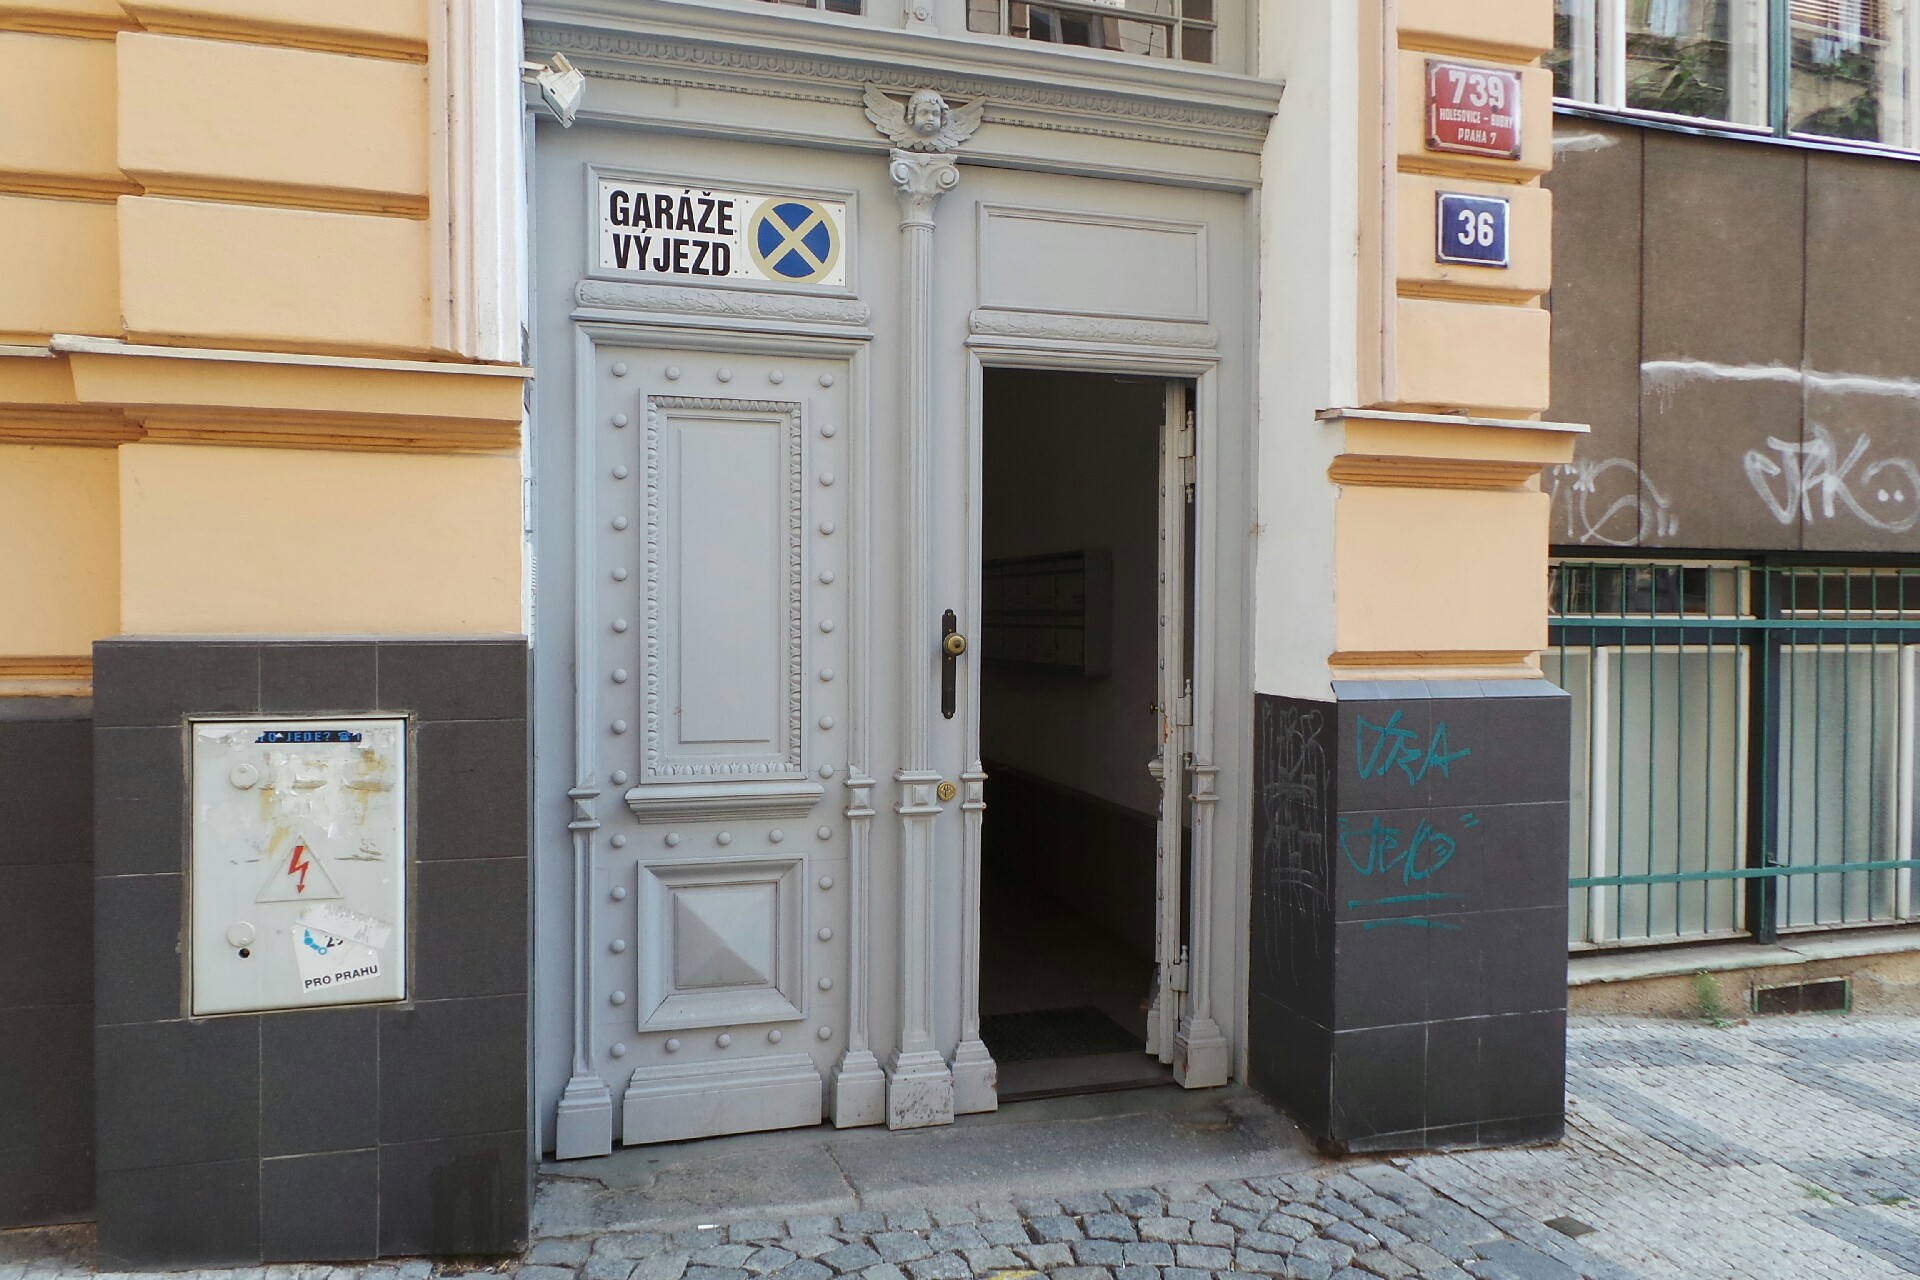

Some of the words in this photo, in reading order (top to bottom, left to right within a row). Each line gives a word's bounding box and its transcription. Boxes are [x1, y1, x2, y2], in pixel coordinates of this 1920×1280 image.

[1448, 70, 1505, 110] 739
[1457, 127, 1488, 144] PRAHA
[1490, 132, 1497, 145] 7
[609, 189, 734, 236] GARÁŽE
[1457, 209, 1494, 247] 36
[612, 228, 731, 277] VÝJEZD
[286, 731, 331, 742] JEDE?
[304, 975, 332, 989] PRO
[335, 964, 379, 982] PRAHU
